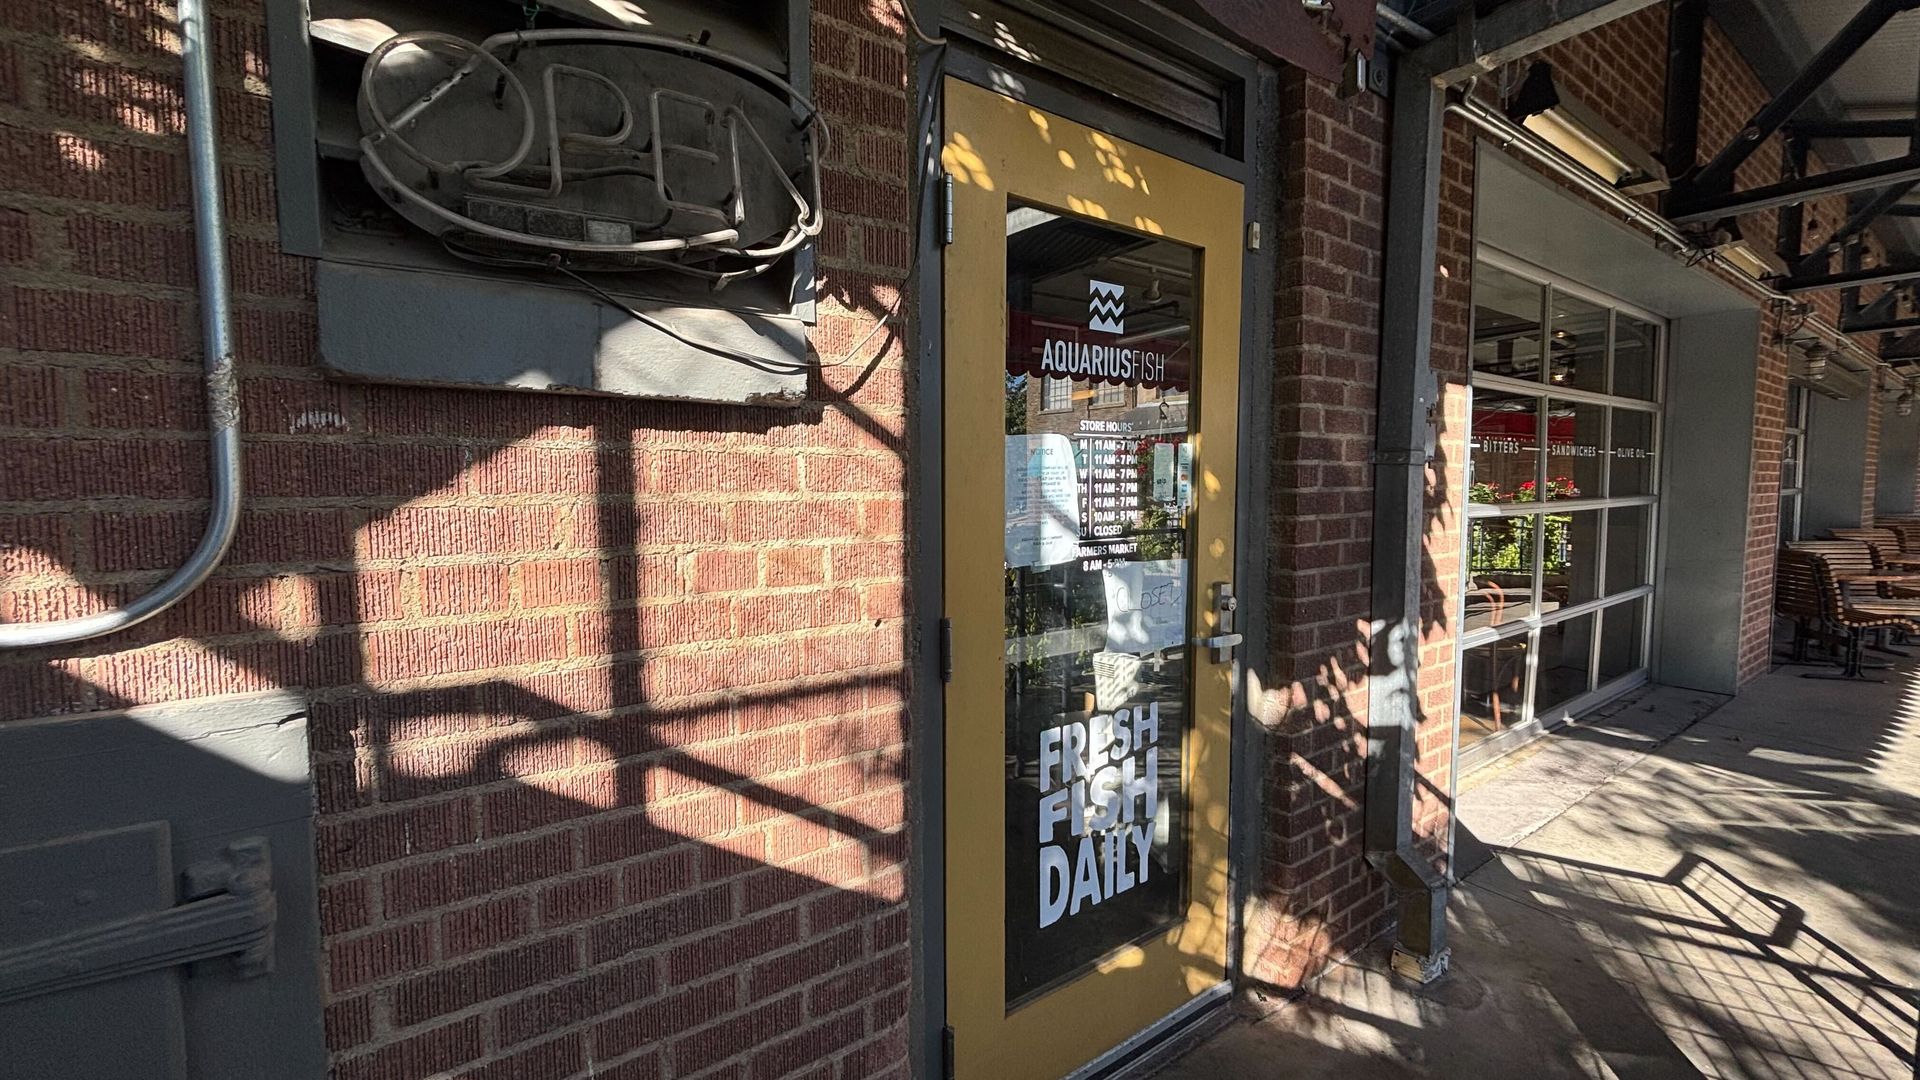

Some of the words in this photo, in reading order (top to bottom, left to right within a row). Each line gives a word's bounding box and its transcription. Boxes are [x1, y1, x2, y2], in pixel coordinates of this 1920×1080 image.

[361, 31, 826, 237] OPEN
[1080, 420, 1106, 431] STORE
[1106, 421, 1132, 432] HOURS
[1080, 439, 1088, 450] M
[1095, 440, 1102, 451] 11
[1103, 440, 1115, 450] AM
[1120, 440, 1125, 450] 7
[1127, 440, 1138, 450] PM
[1483, 440, 1520, 454] BITTERS
[1552, 445, 1597, 457] SANDWICHES
[1030, 448, 1054, 456] NOTICE
[1617, 447, 1635, 458] OLIVE
[1636, 448, 1646, 458] OIL
[1082, 454, 1088, 464] T
[1095, 454, 1102, 465] 11
[1103, 454, 1115, 464] AM
[1120, 454, 1125, 464] 7
[1127, 454, 1138, 464] PM
[1079, 468, 1088, 479] W
[1095, 469, 1102, 480] 11
[1103, 469, 1115, 479] AM
[1120, 469, 1125, 479] 7
[1127, 469, 1138, 479] PM
[1077, 483, 1087, 493] TH
[1094, 483, 1102, 494] 11
[1103, 483, 1115, 493] AM
[1120, 483, 1125, 493] 7
[1127, 483, 1138, 493] PM
[1082, 498, 1088, 508] F
[1094, 497, 1102, 508] 11
[1103, 497, 1115, 507] AM
[1120, 497, 1125, 507] 7
[1127, 497, 1138, 507] PM
[1081, 512, 1088, 523] S
[1094, 511, 1103, 522] 10
[1103, 511, 1115, 521] AM
[1120, 511, 1125, 521] 5
[1127, 511, 1138, 521] PM
[1077, 526, 1087, 537] SU
[1094, 525, 1123, 536] CLOSED
[1109, 543, 1137, 554] MARKET
[1083, 560, 1089, 571] 8
[1090, 560, 1102, 570] AM
[1107, 559, 1113, 569] 5
[1040, 701, 1159, 793] FRESH
[1039, 746, 1158, 844] FISH
[1040, 821, 1157, 929] DAILY
